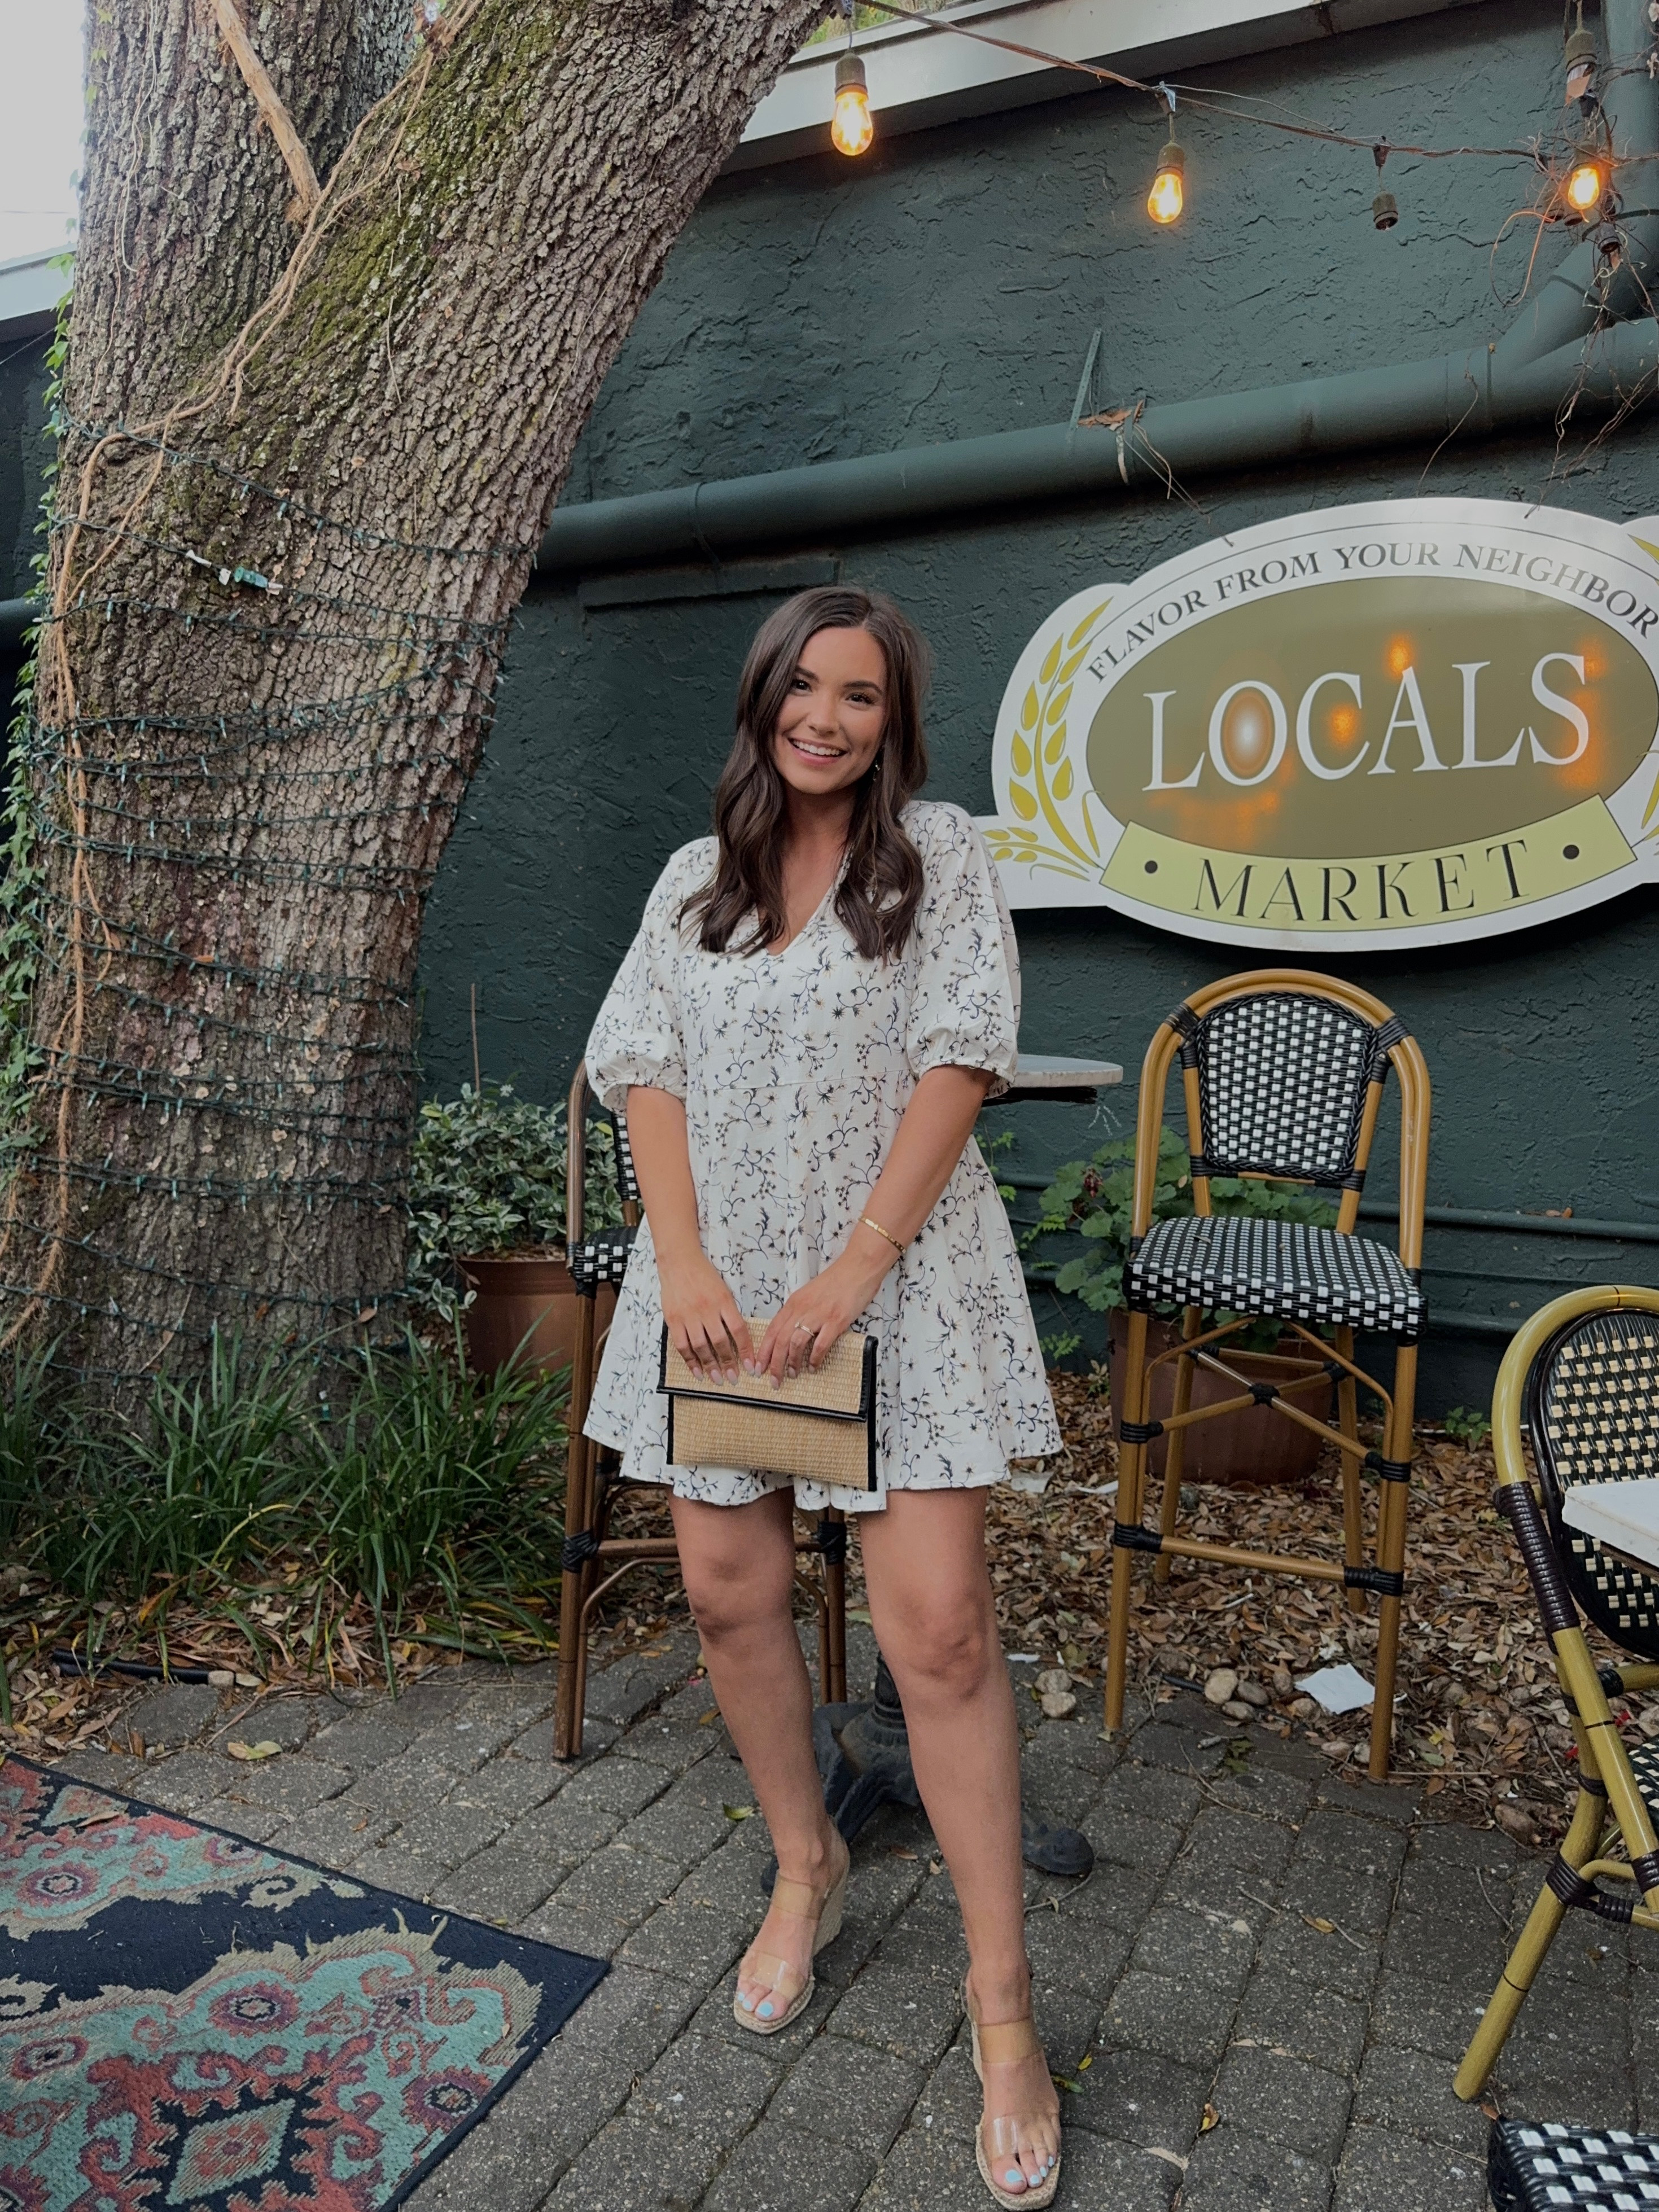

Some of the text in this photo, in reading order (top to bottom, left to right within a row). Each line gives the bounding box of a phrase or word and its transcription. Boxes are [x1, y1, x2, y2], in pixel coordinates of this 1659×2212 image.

[1087, 542, 1658, 684] FLAVOR FROM YOUR NEIGHBOR
[1142, 652, 1589, 791] LOCALS
[1191, 839, 1529, 922] MARKET
